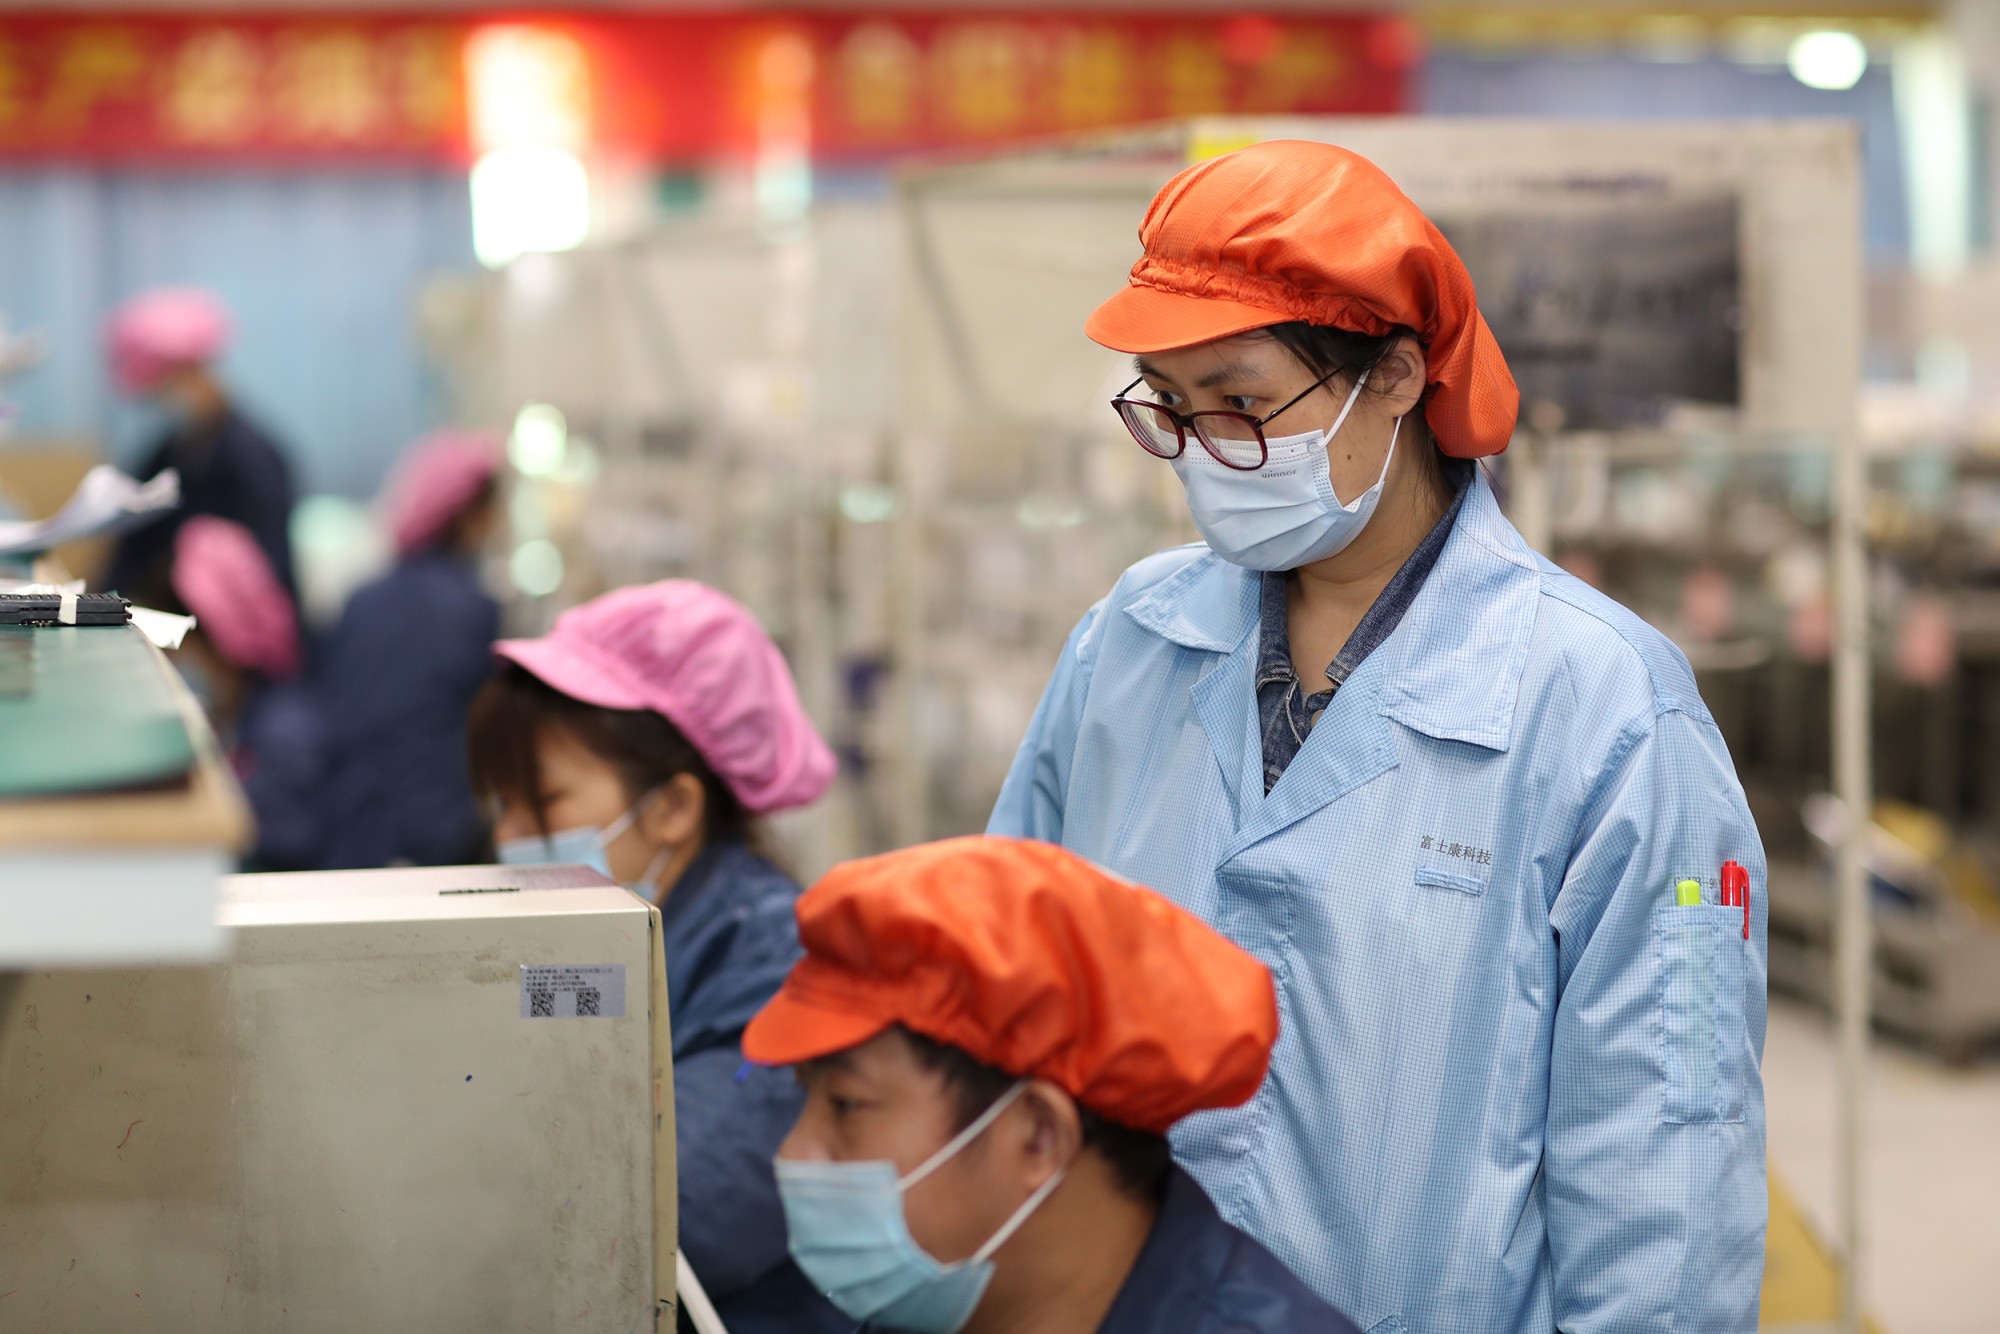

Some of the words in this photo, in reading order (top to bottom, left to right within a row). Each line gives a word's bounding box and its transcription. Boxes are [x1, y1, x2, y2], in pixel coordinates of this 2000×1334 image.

[1261, 469, 1297, 478] winner
[1420, 834, 1492, 866] 富士康科技
